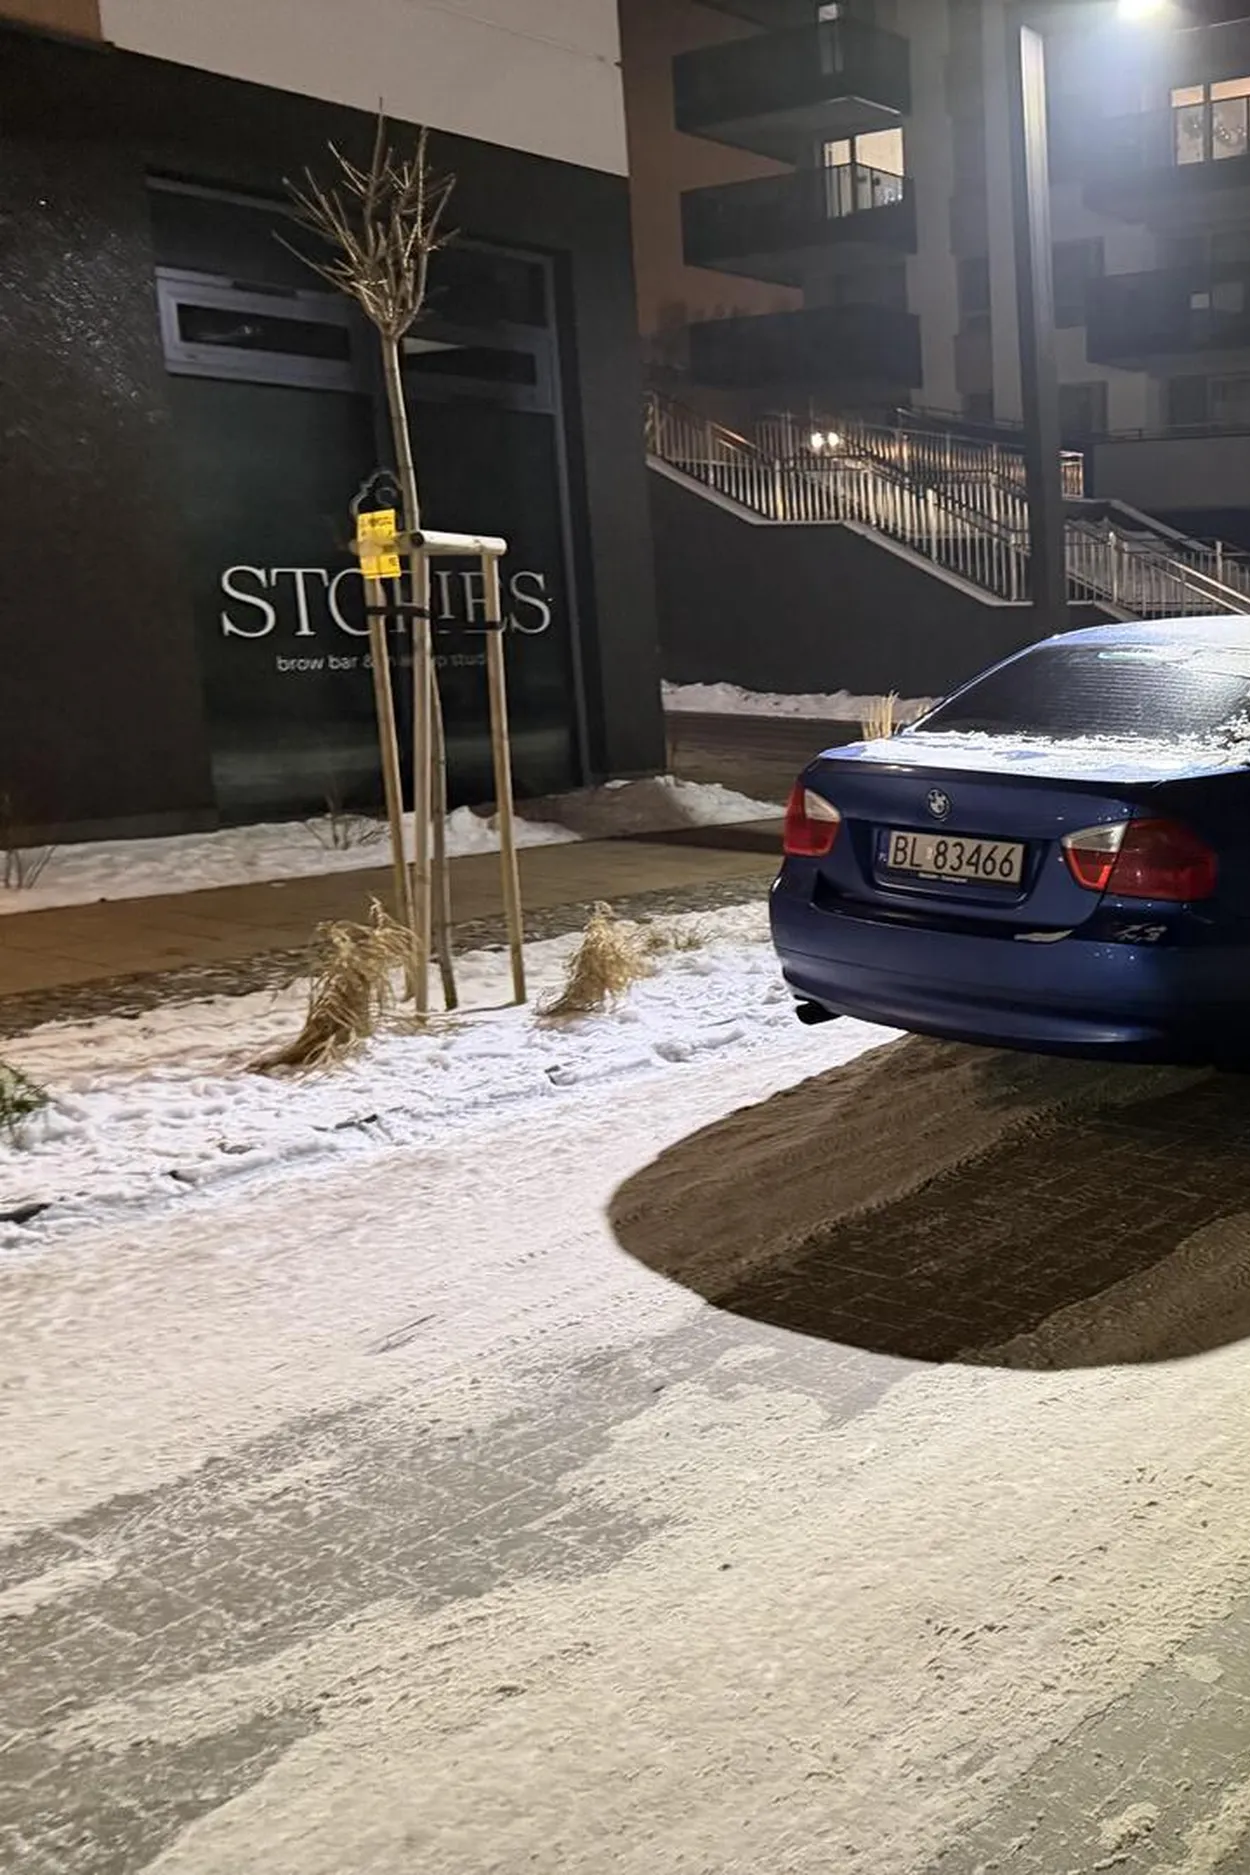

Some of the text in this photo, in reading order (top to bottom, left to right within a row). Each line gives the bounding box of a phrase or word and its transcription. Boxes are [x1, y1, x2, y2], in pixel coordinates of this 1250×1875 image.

[276, 655, 325, 672] brow
[328, 655, 358, 670] bar
[893, 836, 1015, 877] BL 83466
